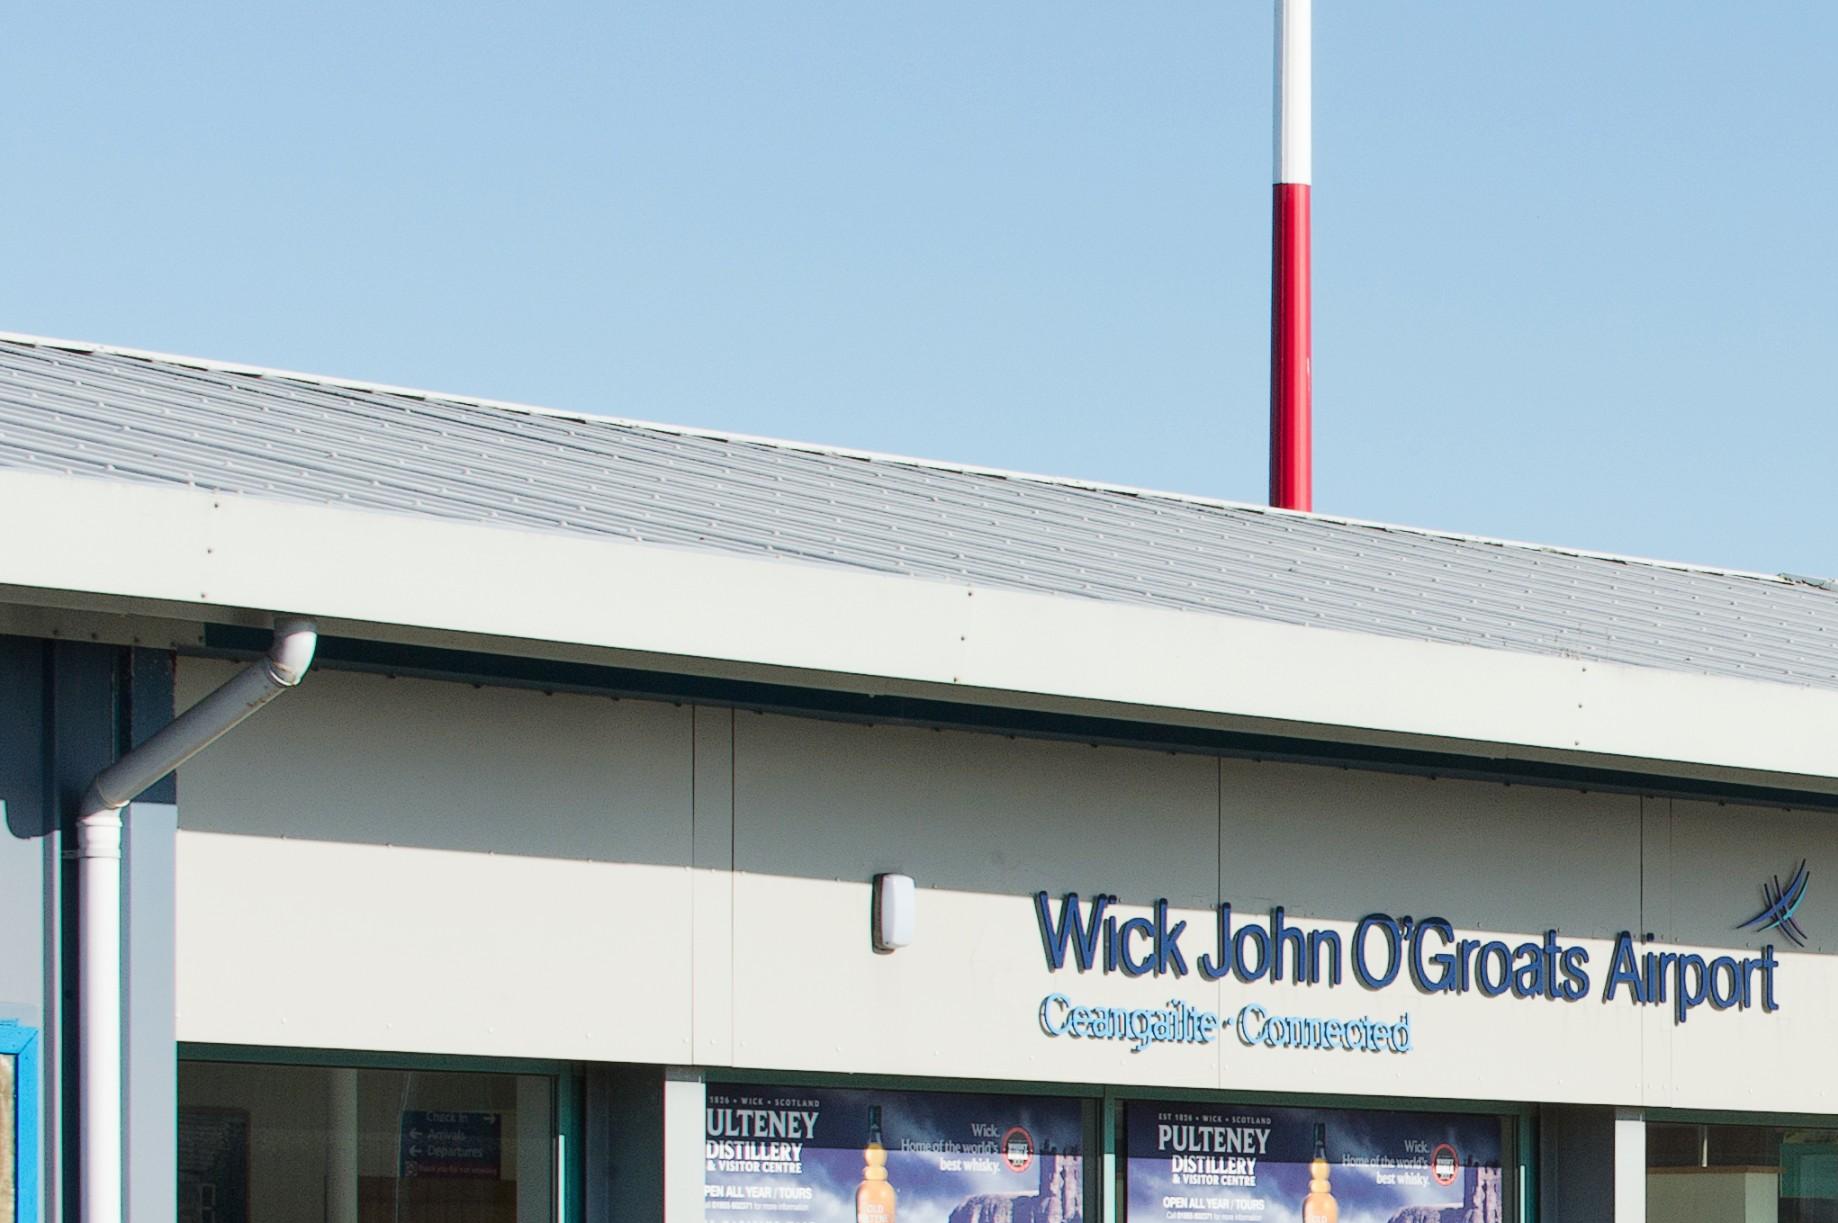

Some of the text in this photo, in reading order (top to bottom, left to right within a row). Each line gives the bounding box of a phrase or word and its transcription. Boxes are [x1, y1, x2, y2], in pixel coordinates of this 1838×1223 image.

[1034, 891, 1779, 1025] Wick John O'Groats Airport
[1039, 992, 1414, 1054] Ceangailte Connected
[741, 1097, 764, 1106] WICK
[775, 1098, 820, 1107] SCOTLAND
[705, 1108, 819, 1139] ULTENEY
[1202, 1114, 1222, 1123] WICK
[1232, 1115, 1272, 1124] SCOTLAND
[901, 1138, 931, 1153] Home
[945, 1140, 961, 1154] the
[1158, 1124, 1271, 1154] PULTENEY
[705, 1140, 803, 1162] DISTILLERY
[706, 1160, 803, 1174] & VISITOR CENTRE
[940, 1157, 962, 1172] best
[1171, 1154, 1256, 1175] DISTILLERY
[1342, 1153, 1369, 1168] Home
[1380, 1155, 1395, 1169] the
[1172, 1174, 1257, 1187] & VISITOR CENTRE
[1376, 1170, 1396, 1185] best
[704, 1184, 724, 1198] PEN
[726, 1185, 745, 1198] ALL
[745, 1186, 771, 1199] YEAR
[779, 1187, 813, 1200] TOURS
[1163, 1196, 1188, 1209] OPEN
[1189, 1196, 1206, 1209] ALL
[1206, 1197, 1229, 1210] YEAR
[1236, 1199, 1265, 1211] TOURS
